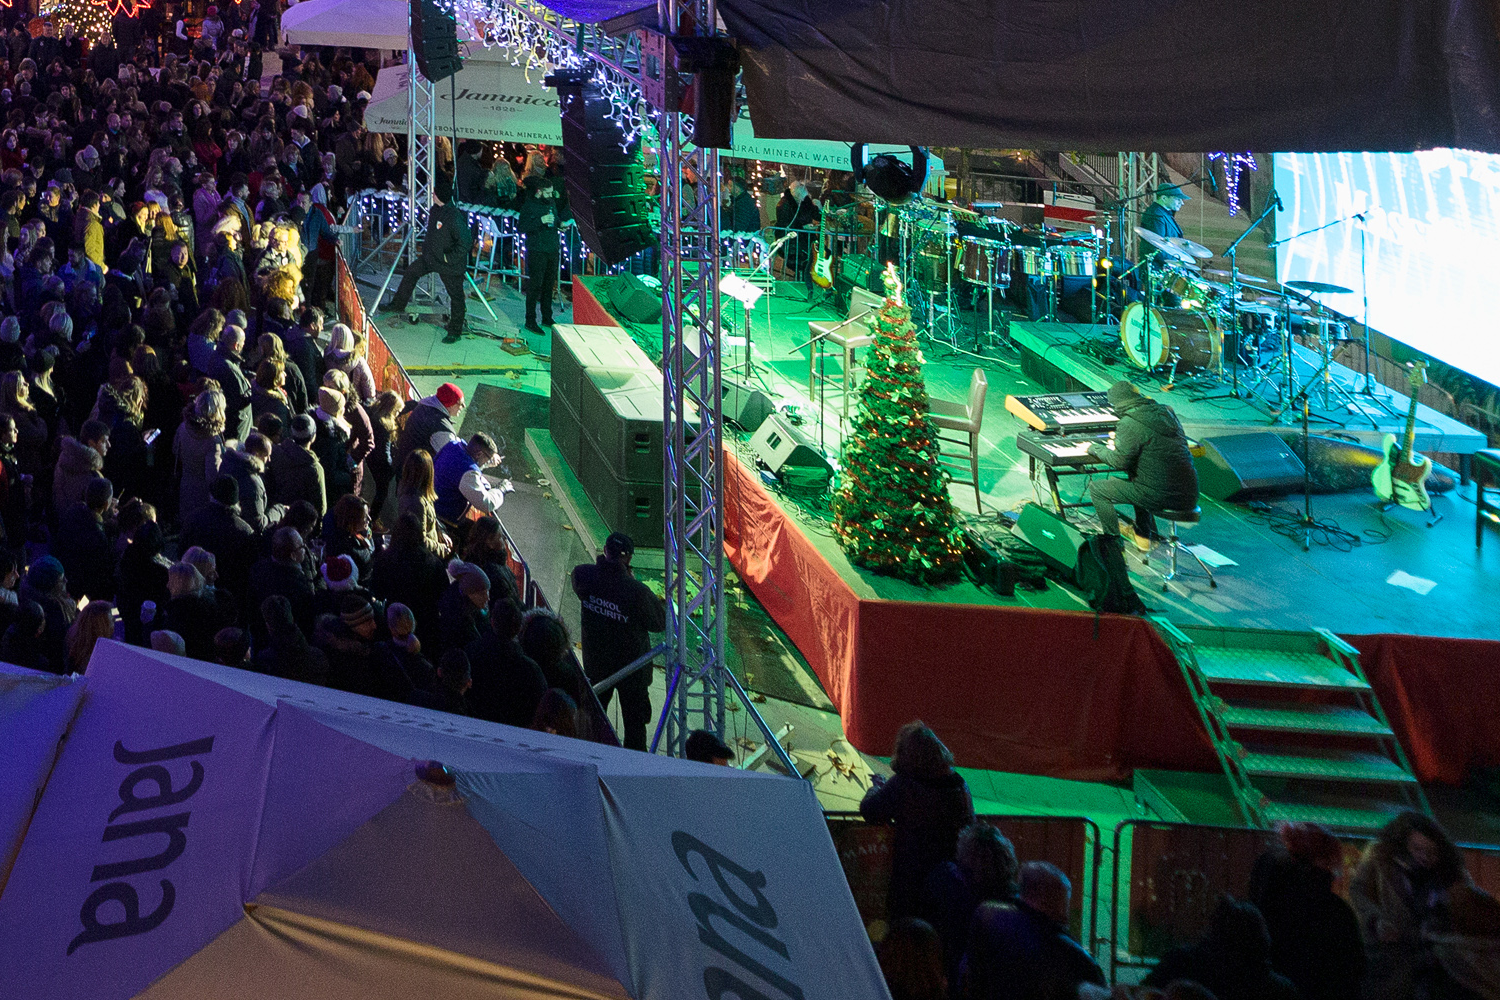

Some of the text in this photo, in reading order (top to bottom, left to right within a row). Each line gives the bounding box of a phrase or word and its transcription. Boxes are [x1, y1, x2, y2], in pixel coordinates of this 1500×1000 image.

[440, 88, 560, 108] Jamnica
[477, 128, 514, 137] NATURAL
[517, 131, 552, 140] MINERAL
[763, 147, 810, 161] MINERAL
[812, 153, 850, 165] WATER
[582, 600, 629, 623] SECURITY
[589, 594, 621, 613] SOKOL
[67, 735, 215, 956] Jana
